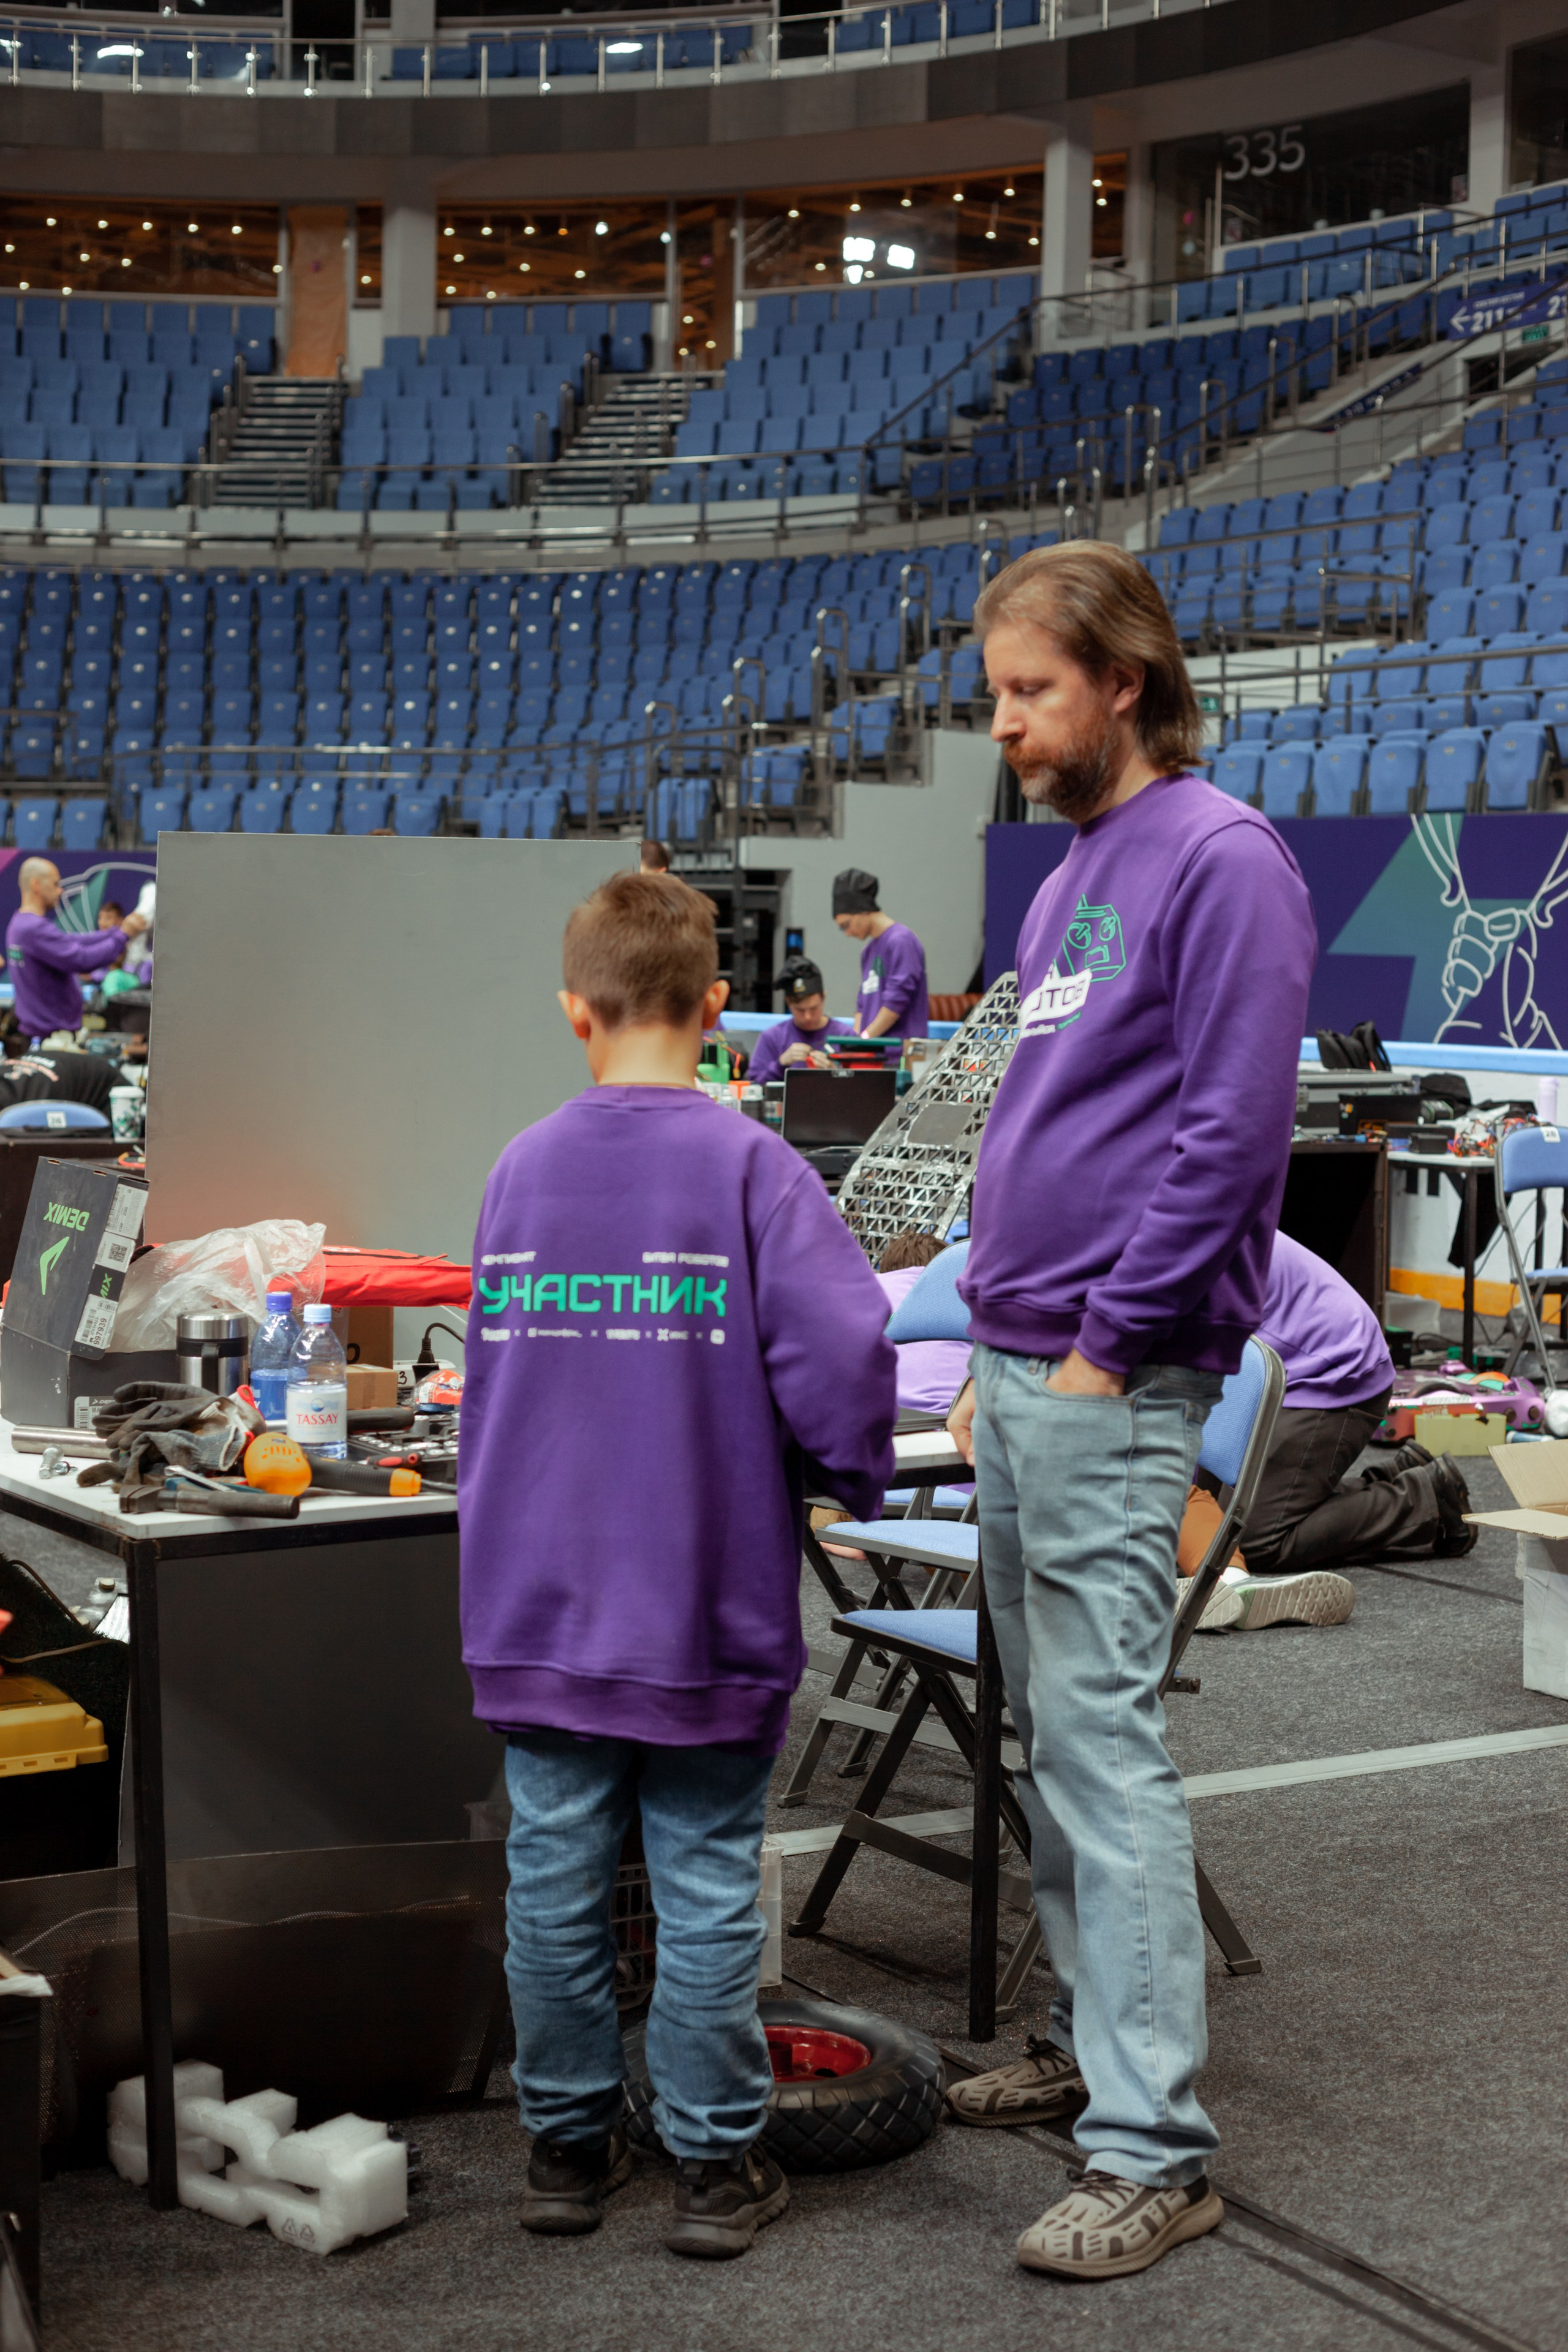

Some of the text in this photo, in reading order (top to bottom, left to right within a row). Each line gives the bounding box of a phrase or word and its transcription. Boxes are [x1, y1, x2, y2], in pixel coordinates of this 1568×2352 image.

[1224, 126, 1306, 181] 335
[43, 1202, 90, 1232] DEMIX
[100, 1273, 113, 1298] MIX
[478, 1273, 728, 1317] УЧАСТНИК
[93, 1318, 107, 1345] 997939
[295, 1412, 339, 1425] TASSAY
